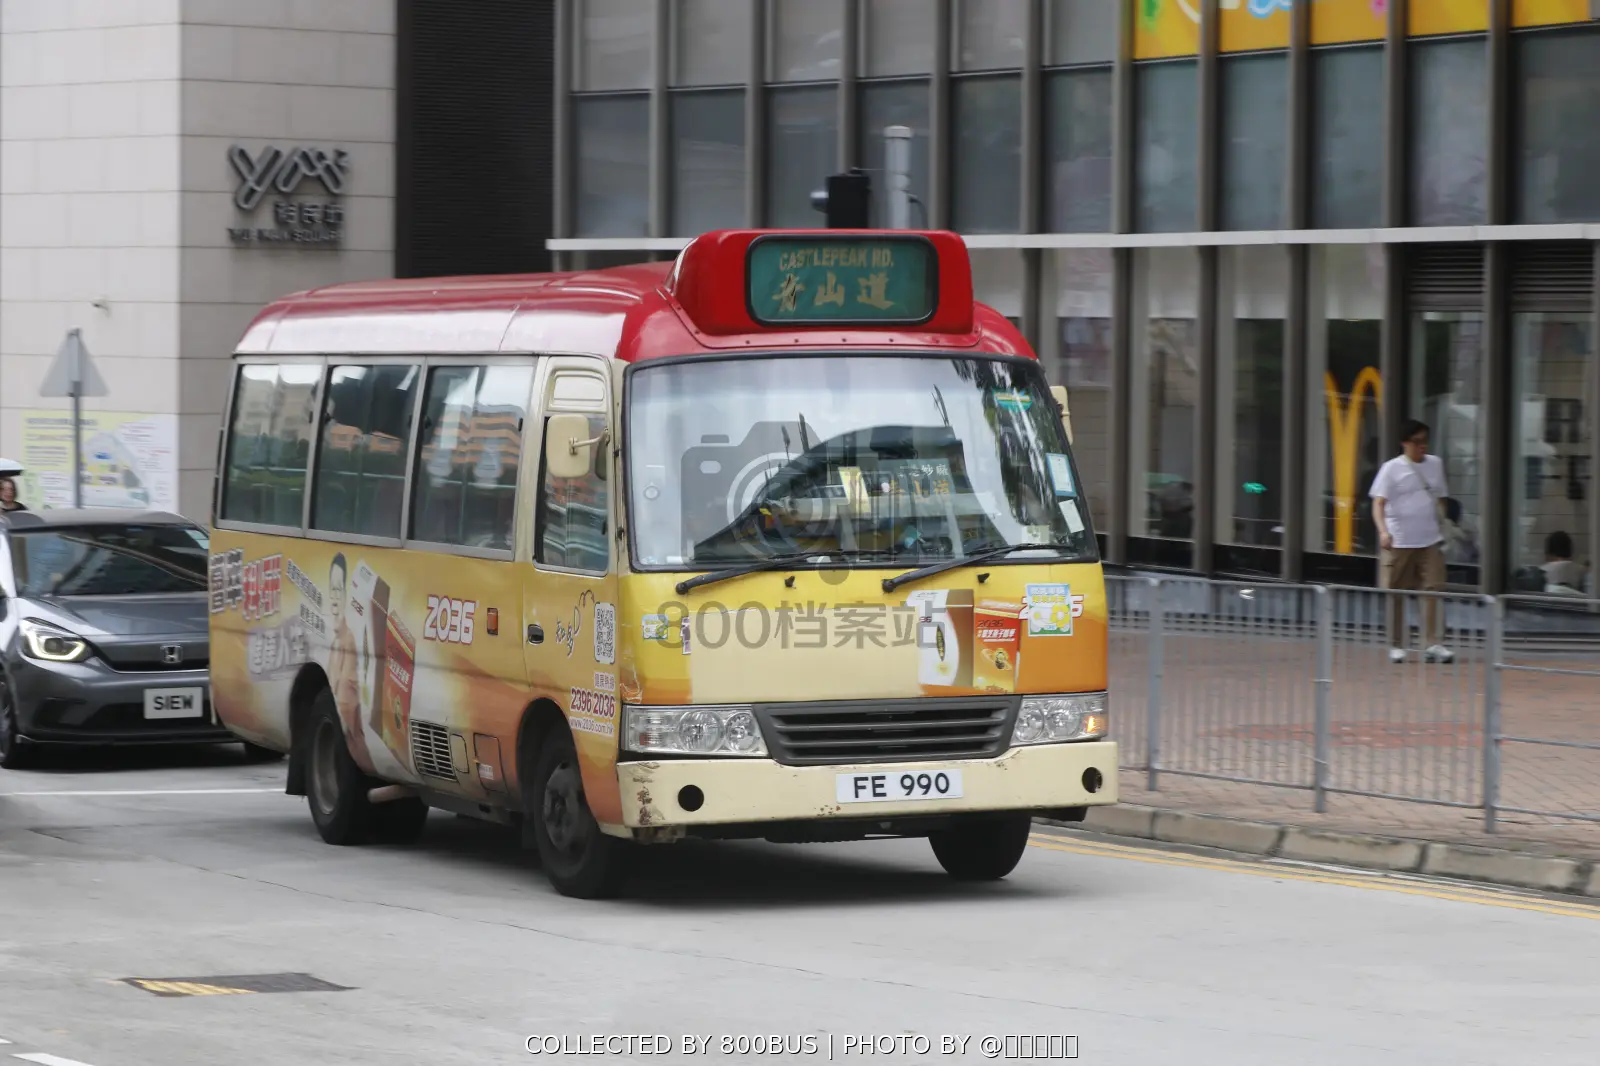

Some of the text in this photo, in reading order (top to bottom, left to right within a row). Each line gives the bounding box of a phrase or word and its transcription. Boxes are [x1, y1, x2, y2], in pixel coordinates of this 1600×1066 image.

[779, 247, 894, 271] CASTLEPEAK RD.
[772, 271, 896, 312] 青山道
[424, 594, 477, 645] 2036
[570, 687, 616, 718] 2396 2036
[853, 772, 950, 799] FE 990
